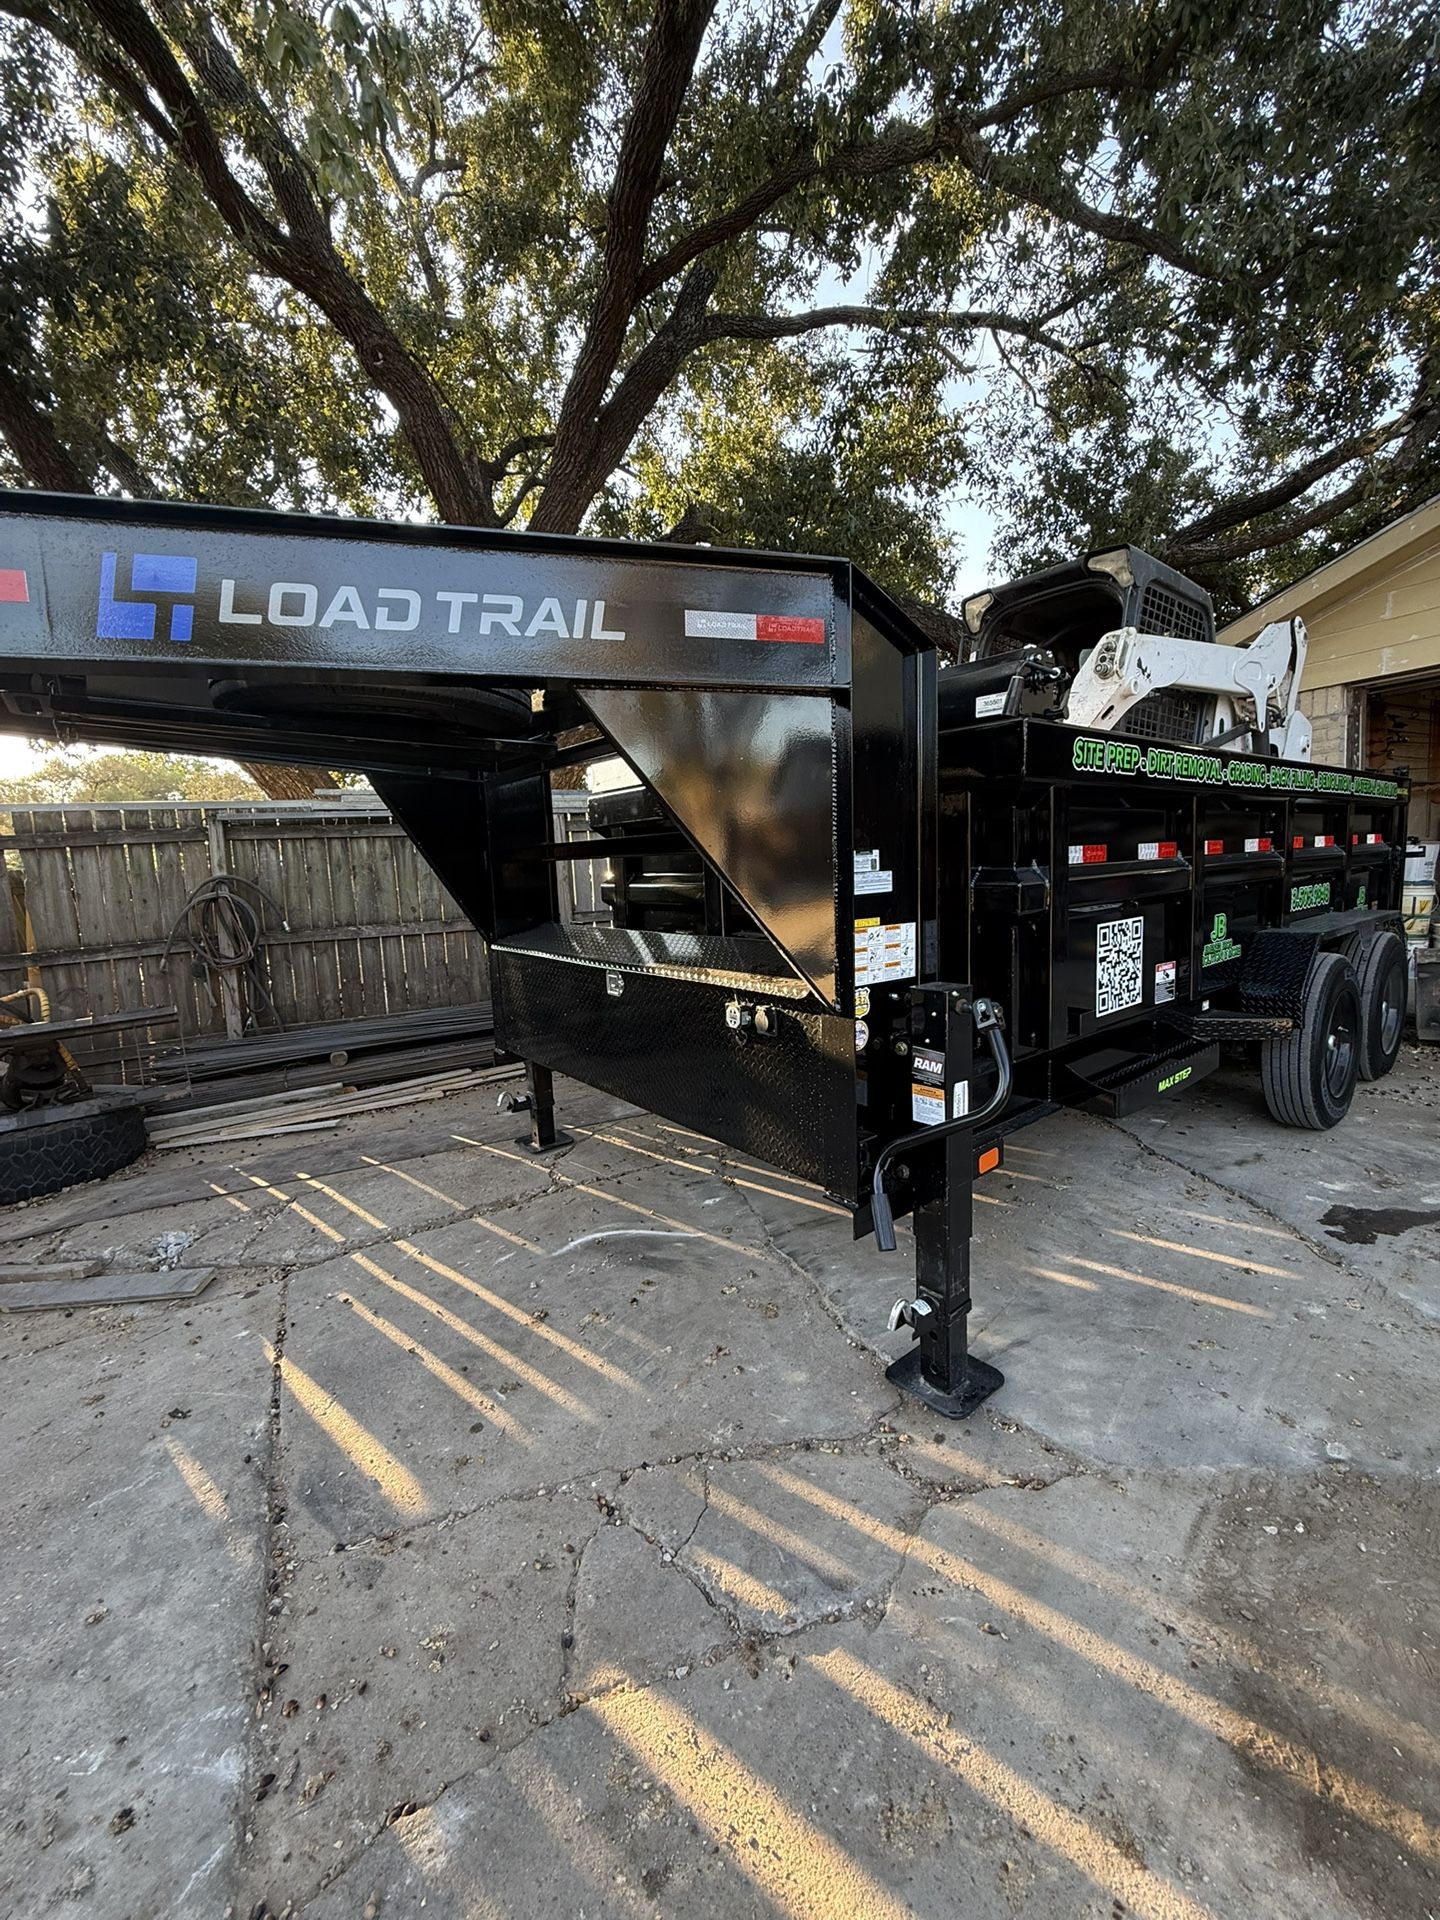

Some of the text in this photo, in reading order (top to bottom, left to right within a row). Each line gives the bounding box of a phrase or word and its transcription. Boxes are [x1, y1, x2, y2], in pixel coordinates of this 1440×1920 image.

[218, 578, 422, 632] LOAD
[436, 591, 626, 641] TRAIL
[1073, 737, 1106, 772] SITE
[1106, 742, 1141, 775] PREP
[1147, 748, 1175, 779] DIRT
[1174, 752, 1223, 784] REMOVAL
[1228, 760, 1267, 787] GRADING
[1270, 766, 1291, 789] BACK
[1290, 768, 1315, 791] FILLING
[1210, 912, 1227, 943] JB
[913, 1057, 943, 1075] RAM
[1158, 1066, 1192, 1093] MAX STEP
